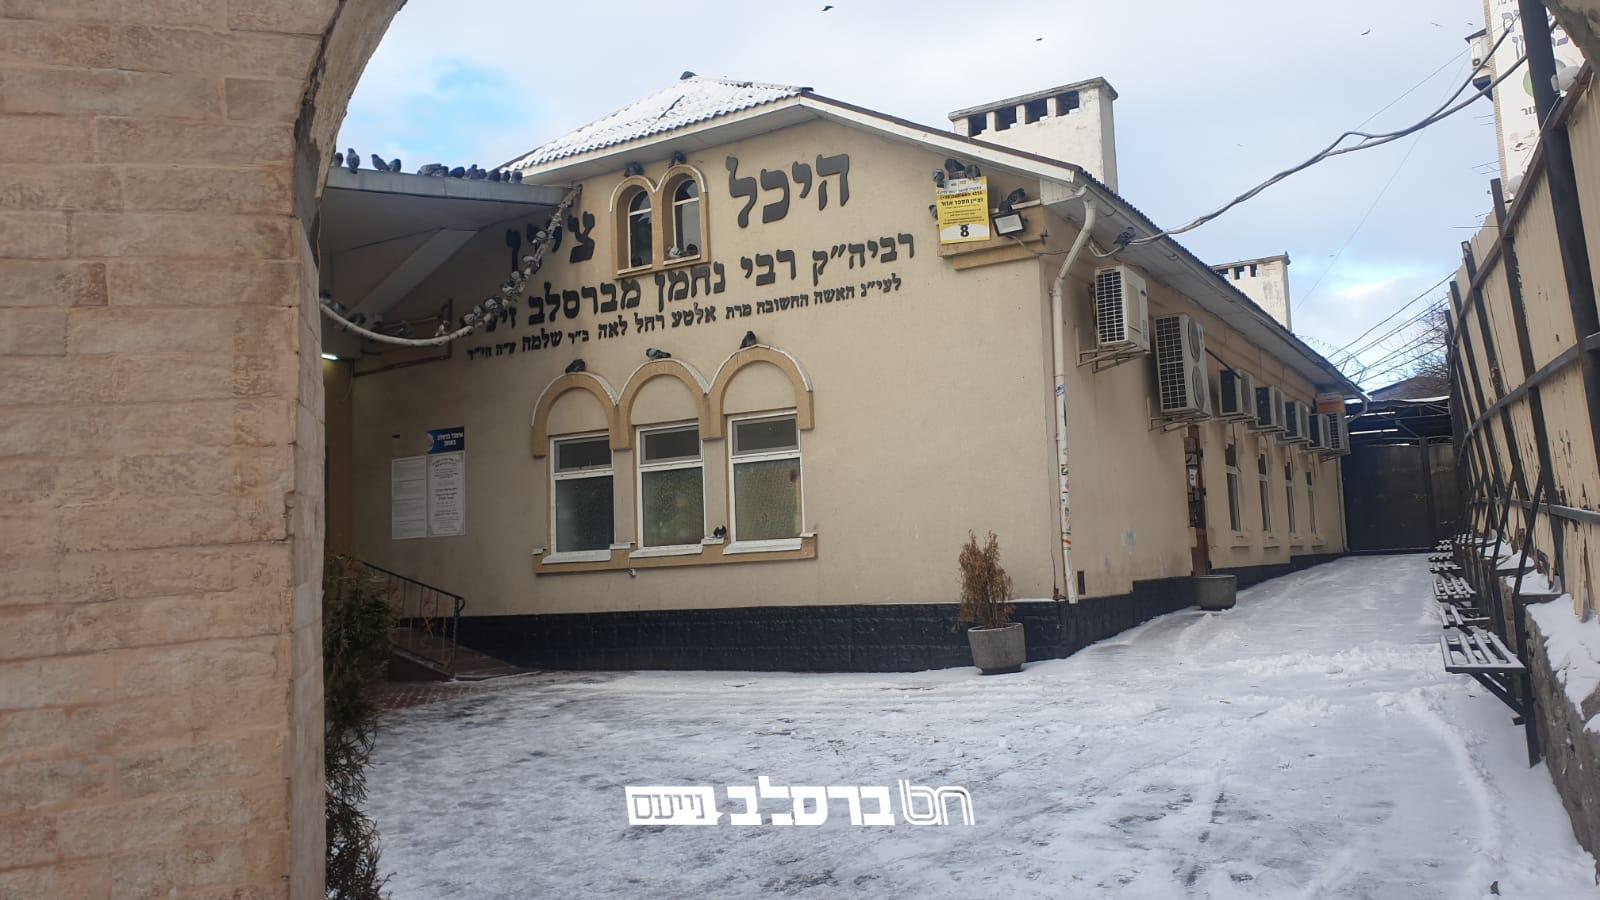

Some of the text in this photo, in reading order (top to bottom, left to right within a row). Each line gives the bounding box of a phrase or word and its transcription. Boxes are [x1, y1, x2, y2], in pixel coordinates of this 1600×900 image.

[725, 153, 850, 229] היכל
[960, 225, 970, 237] 8
[740, 248, 797, 286] רבי
[654, 261, 726, 312] נחמן
[813, 285, 855, 304] האשה
[528, 278, 641, 325] מברסלב
[725, 303, 752, 320] מרת
[756, 293, 809, 315] החשובה
[598, 315, 628, 340] לאה
[634, 312, 665, 334] רחל
[671, 302, 717, 328] אלטע
[522, 327, 563, 352] שלמה
